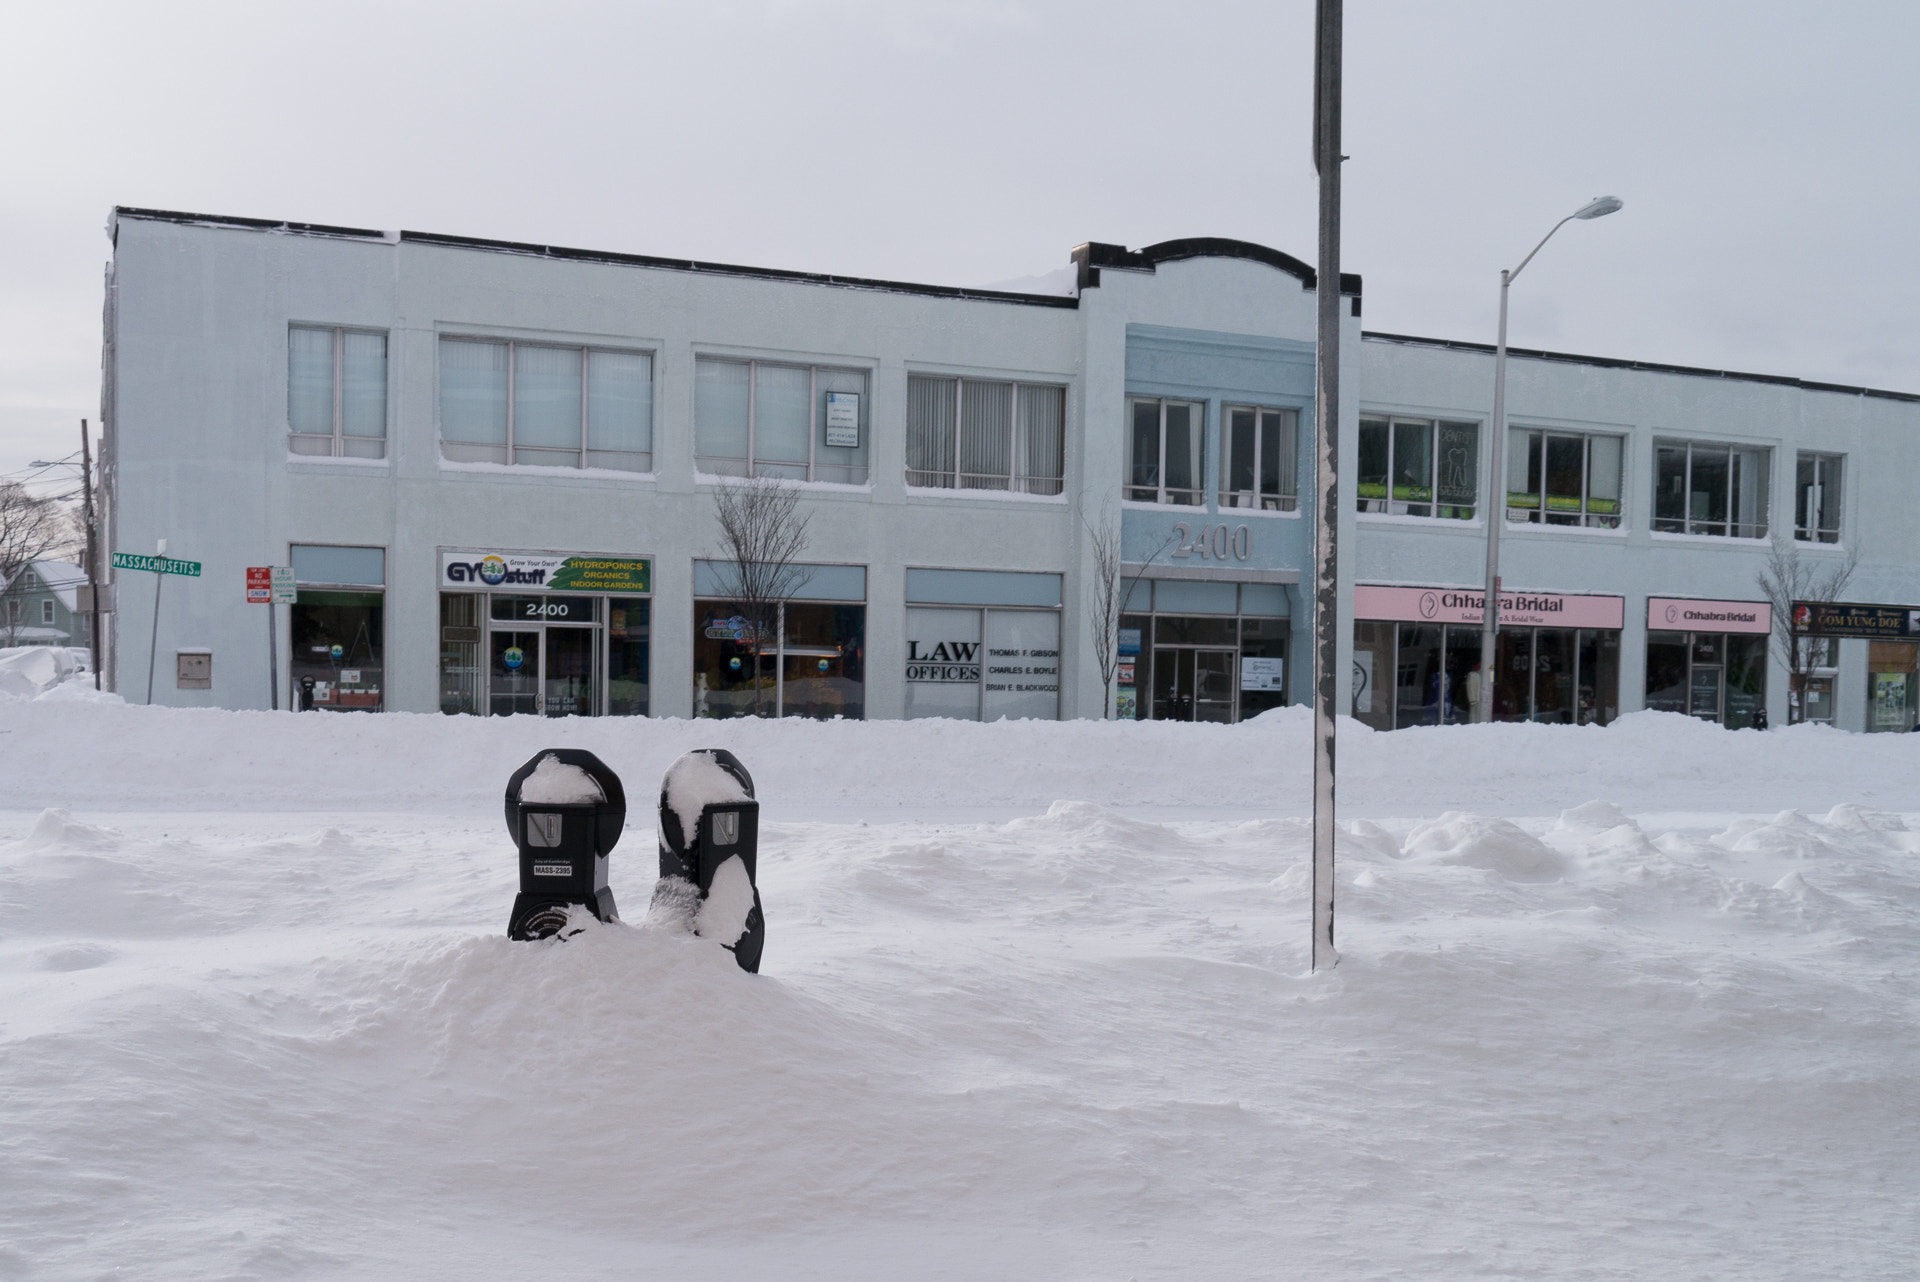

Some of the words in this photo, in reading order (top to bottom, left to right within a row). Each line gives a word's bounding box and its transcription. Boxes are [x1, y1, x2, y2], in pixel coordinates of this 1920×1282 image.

[1171, 522, 1253, 561] 2400
[113, 554, 195, 575] MASSACHUSETTS
[510, 559, 525, 568] Grow
[527, 560, 541, 568] Your
[570, 560, 643, 571] HYDROPONICS
[584, 571, 630, 580] ORGANICS
[570, 581, 602, 589] INDOOR
[604, 582, 643, 591] GARDENS
[1442, 593, 1513, 610] Chhara
[1516, 596, 1563, 612] Bridal
[526, 603, 568, 616] 2400
[1461, 612, 1481, 621] Indian
[1511, 615, 1529, 623] Bridal
[1683, 610, 1726, 621] Chhabra
[1727, 612, 1756, 622] Bridal
[1846, 616, 1876, 627] YUNG
[1878, 618, 1901, 628] DOE
[907, 641, 980, 662] LAW
[989, 649, 1020, 657] THOMAS
[1030, 650, 1058, 658] GIBSON
[906, 665, 980, 680] OFFICES
[988, 666, 1023, 675] CHARLES
[1033, 666, 1057, 675] BOYLE
[986, 684, 1006, 692] BRIAN
[1007, 684, 1014, 692] E.
[1016, 684, 1058, 693] BLACKWOOD
[535, 866, 571, 874] MASS-2395
